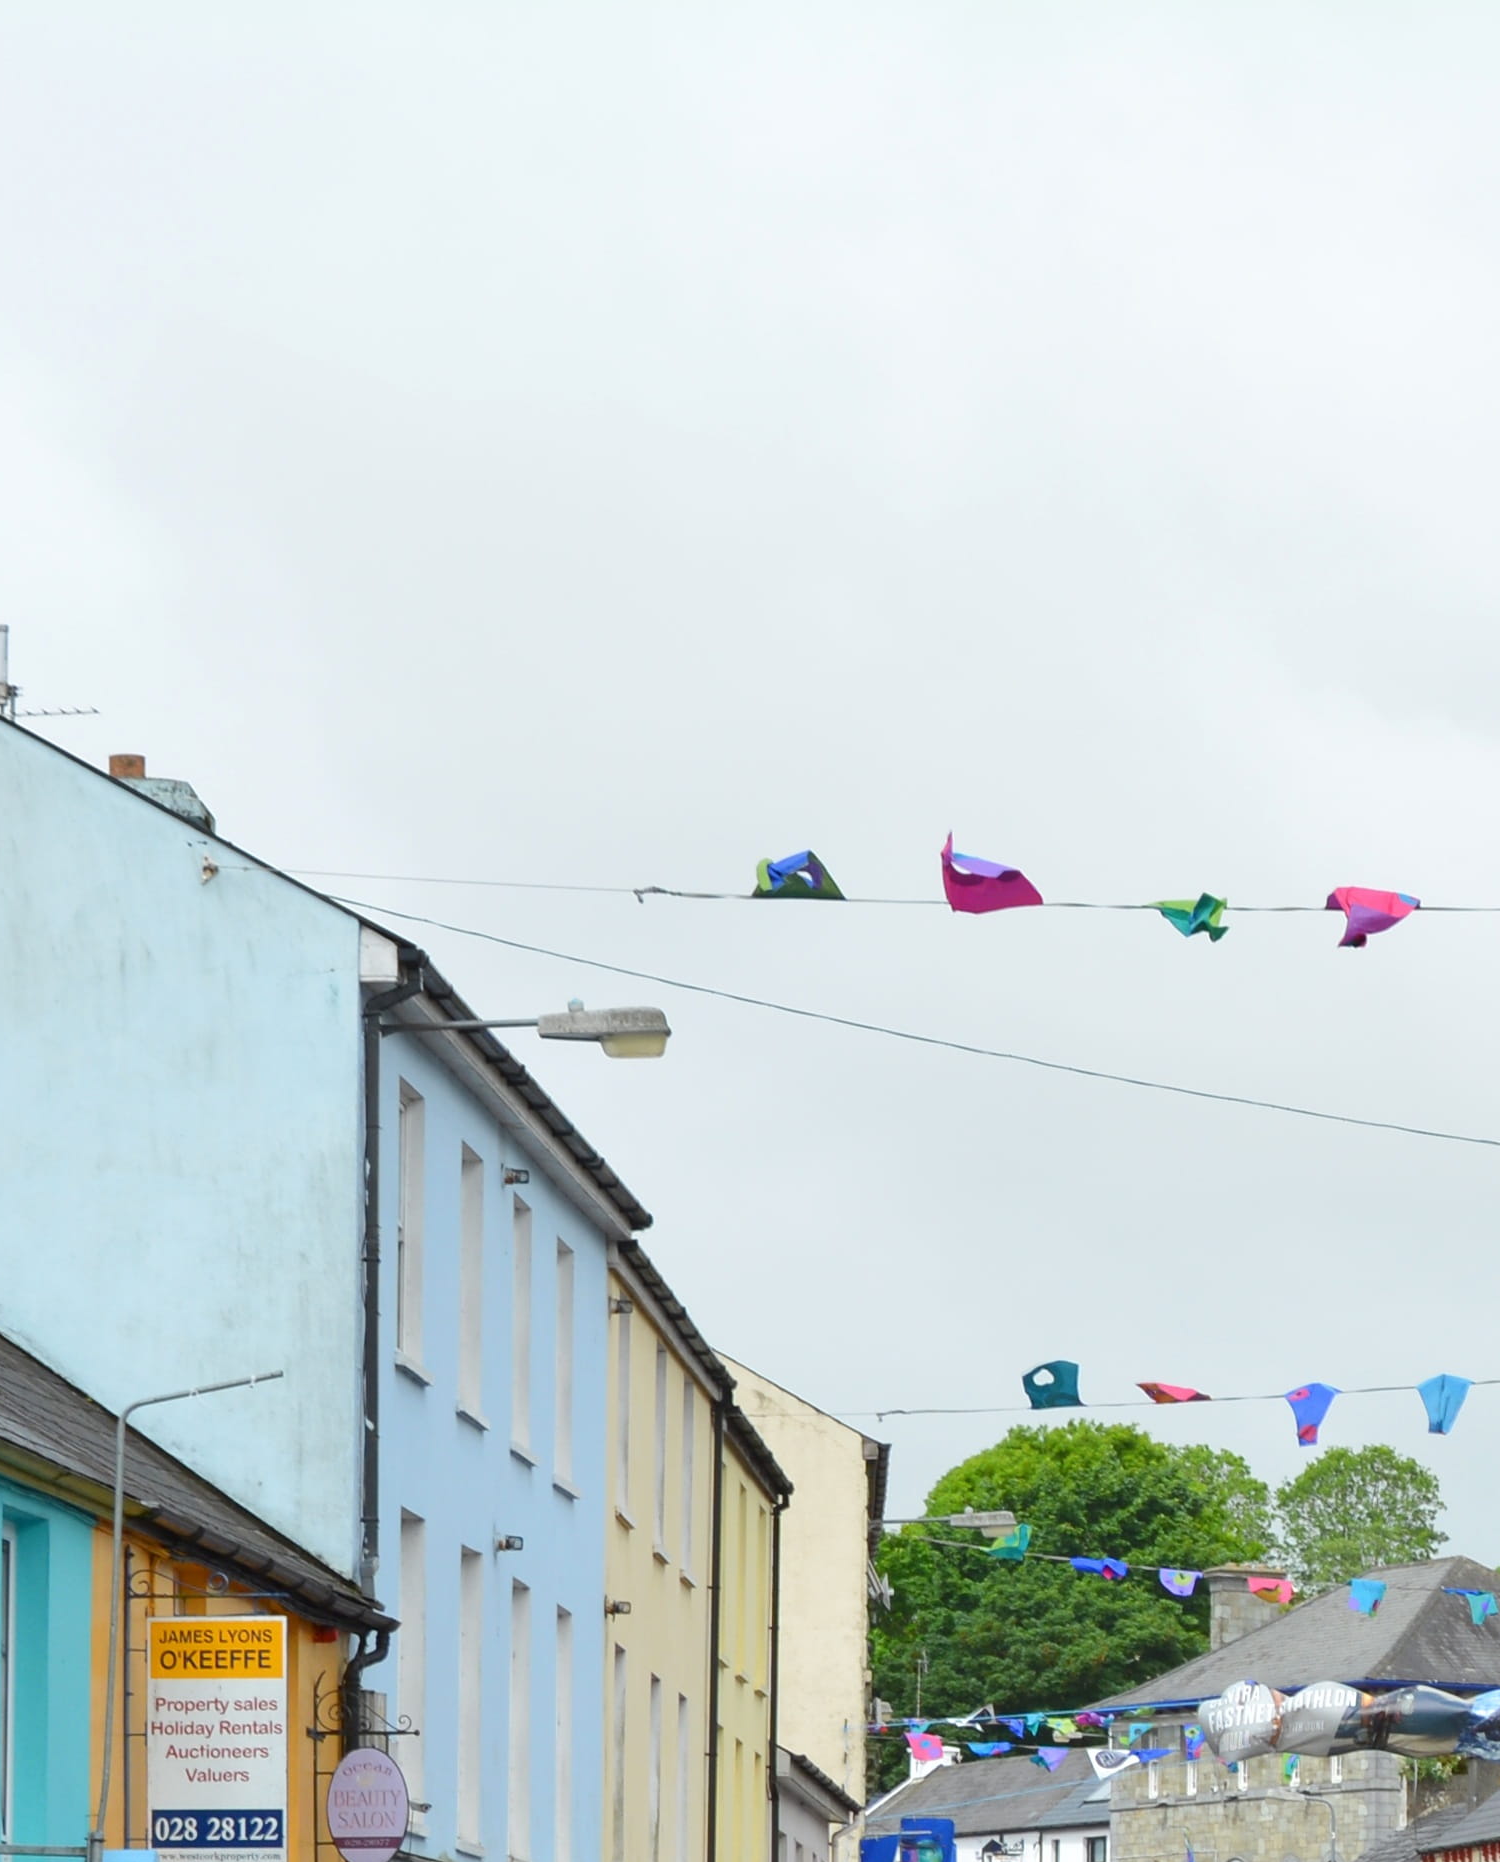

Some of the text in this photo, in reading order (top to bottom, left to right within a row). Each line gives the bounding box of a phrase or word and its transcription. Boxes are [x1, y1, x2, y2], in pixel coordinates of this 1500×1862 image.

[159, 1629, 273, 1644] JAMES LYONS
[160, 1650, 271, 1670] O'KEEFFE
[155, 1698, 278, 1715] Property sales
[1208, 1702, 1276, 1734] FASTNET
[151, 1721, 283, 1739] Holiday Rentals
[165, 1744, 269, 1760] Auctioneers
[185, 1768, 250, 1783] Valuers
[333, 1789, 400, 1808] BEAUTY
[155, 1817, 279, 1841] 028 28122
[337, 1811, 397, 1829] SALON
